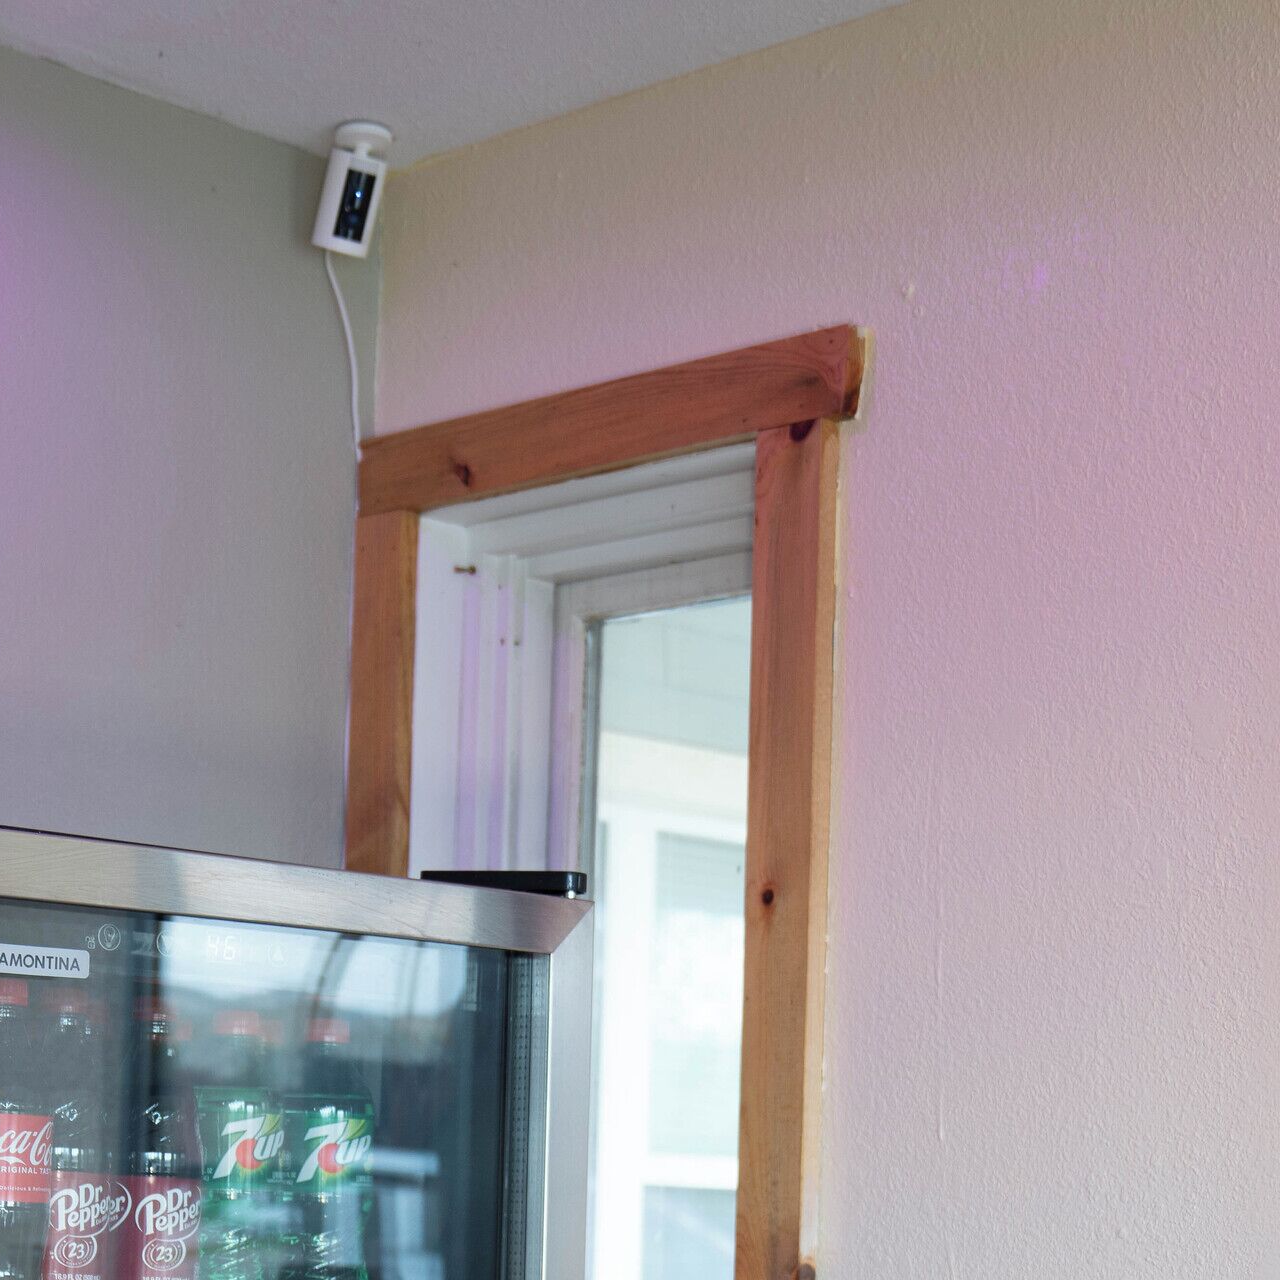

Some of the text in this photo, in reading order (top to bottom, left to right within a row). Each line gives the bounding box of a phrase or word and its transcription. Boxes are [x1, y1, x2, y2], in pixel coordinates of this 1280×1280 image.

[78, 1183, 103, 1209] Dr
[167, 1188, 192, 1213] Dr
[67, 1242, 85, 1259] 23
[156, 1245, 173, 1262] 23
